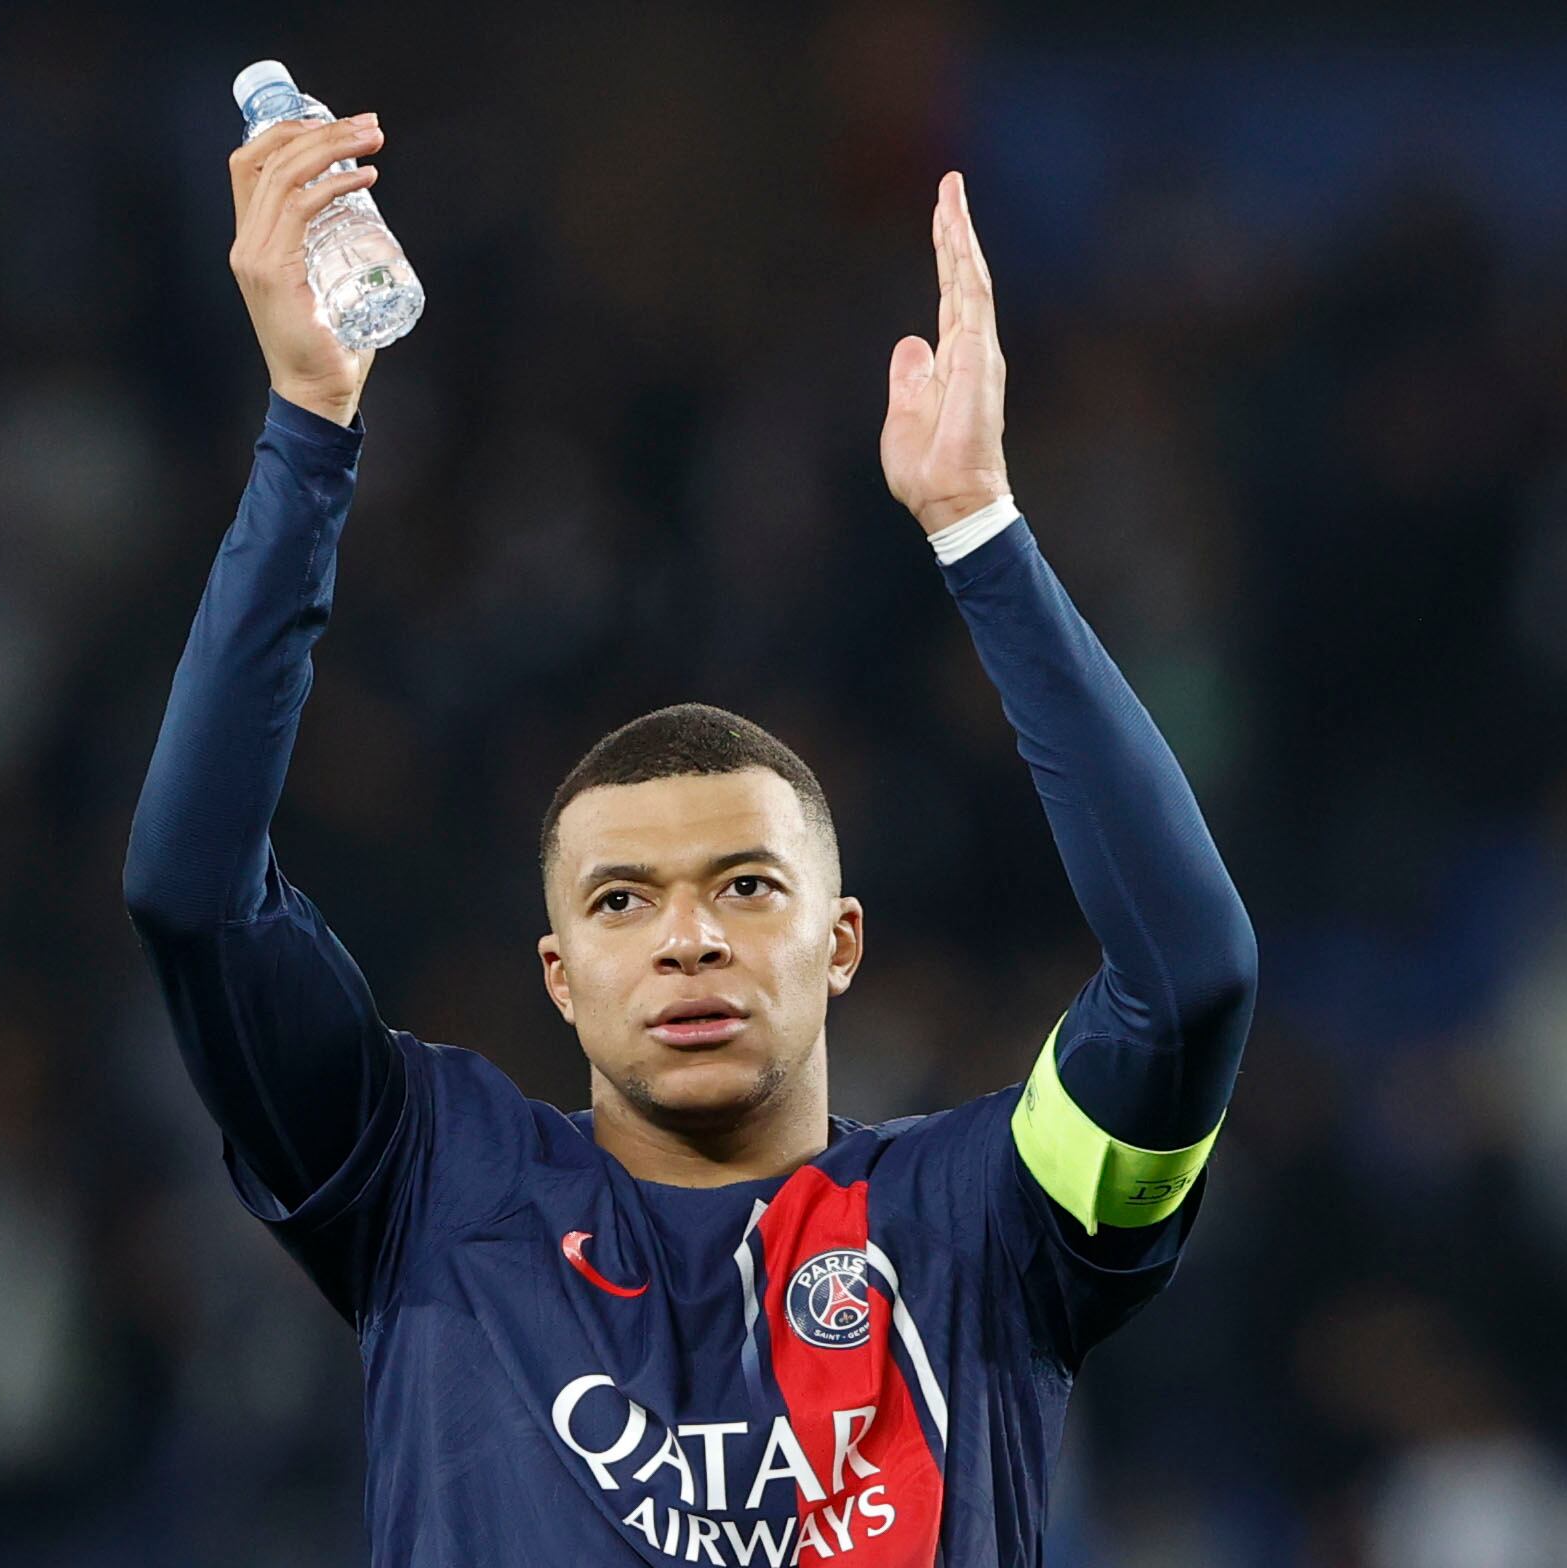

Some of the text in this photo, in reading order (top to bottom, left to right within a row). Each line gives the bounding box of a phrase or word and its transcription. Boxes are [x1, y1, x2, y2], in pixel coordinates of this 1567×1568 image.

[1128, 1177, 1190, 1200] ECT
[797, 1255, 866, 1288] PARIS
[551, 1374, 881, 1511] QATAR
[622, 1485, 897, 1568] AIRWAYS
